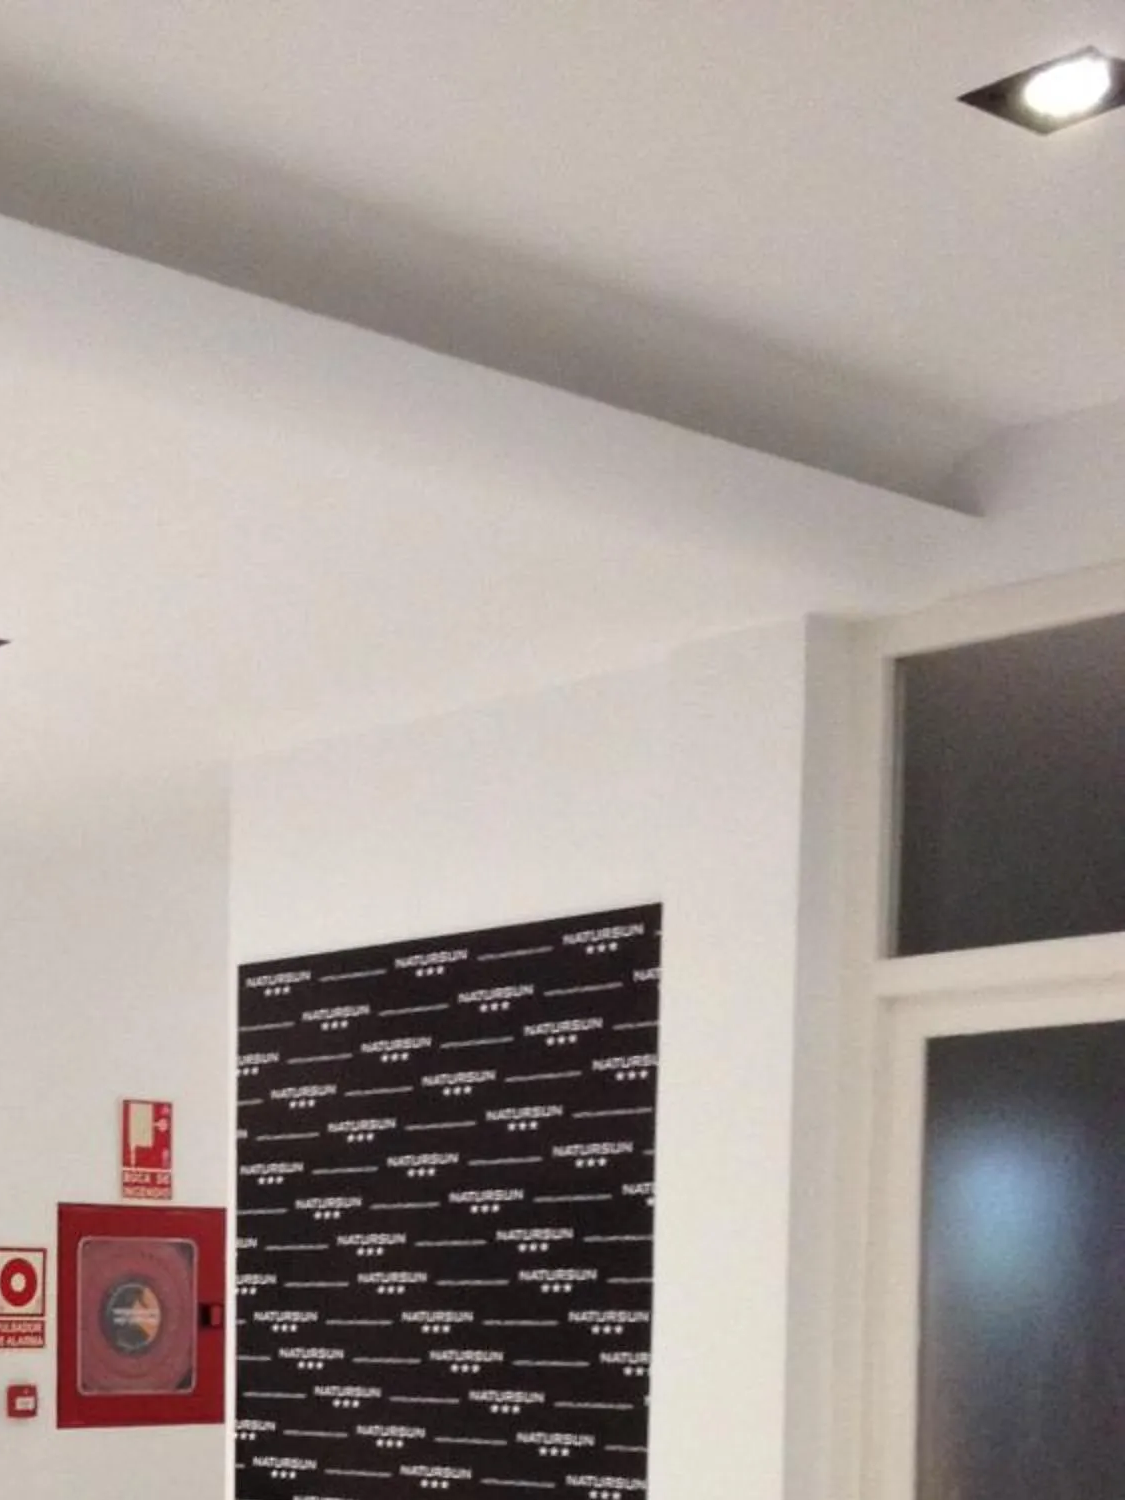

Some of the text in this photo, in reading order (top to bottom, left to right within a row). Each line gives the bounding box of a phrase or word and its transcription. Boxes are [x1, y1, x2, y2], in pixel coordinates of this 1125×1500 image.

[245, 924, 644, 988] NATURSUN NATURSUN NATURSUN
[301, 1004, 371, 1021] NATURSUN
[458, 984, 534, 1003] NATURSUN
[360, 1036, 432, 1053] NATURSUN
[523, 1017, 604, 1036] NATURSUN
[270, 1084, 337, 1100] NATURSUN
[421, 1070, 496, 1087] NATURSUN
[327, 1105, 563, 1133] NATURSUN NATURSUN
[239, 1141, 634, 1175] NATURSUN NATURSUN NATURSUN
[294, 1197, 363, 1210] NATURSUN
[448, 1188, 524, 1203] NATURSUN
[336, 1232, 407, 1246] NATURSUN
[495, 1227, 574, 1241] NATURSUN
[357, 1271, 428, 1284] NATURSUN
[518, 1268, 598, 1282] NATURSUN
[253, 1310, 650, 1324] NATURSUN NATURSUN NATURSUN
[278, 1347, 345, 1360] NATURSUN
[429, 1349, 504, 1363] NATURSUN
[314, 1385, 545, 1404] NATURSUN NATURSUN
[356, 1424, 426, 1439] NATURSUN
[516, 1431, 595, 1447] NATURSUN
[252, 1455, 648, 1491] NATURSUN NATURSUN NATURSUN
